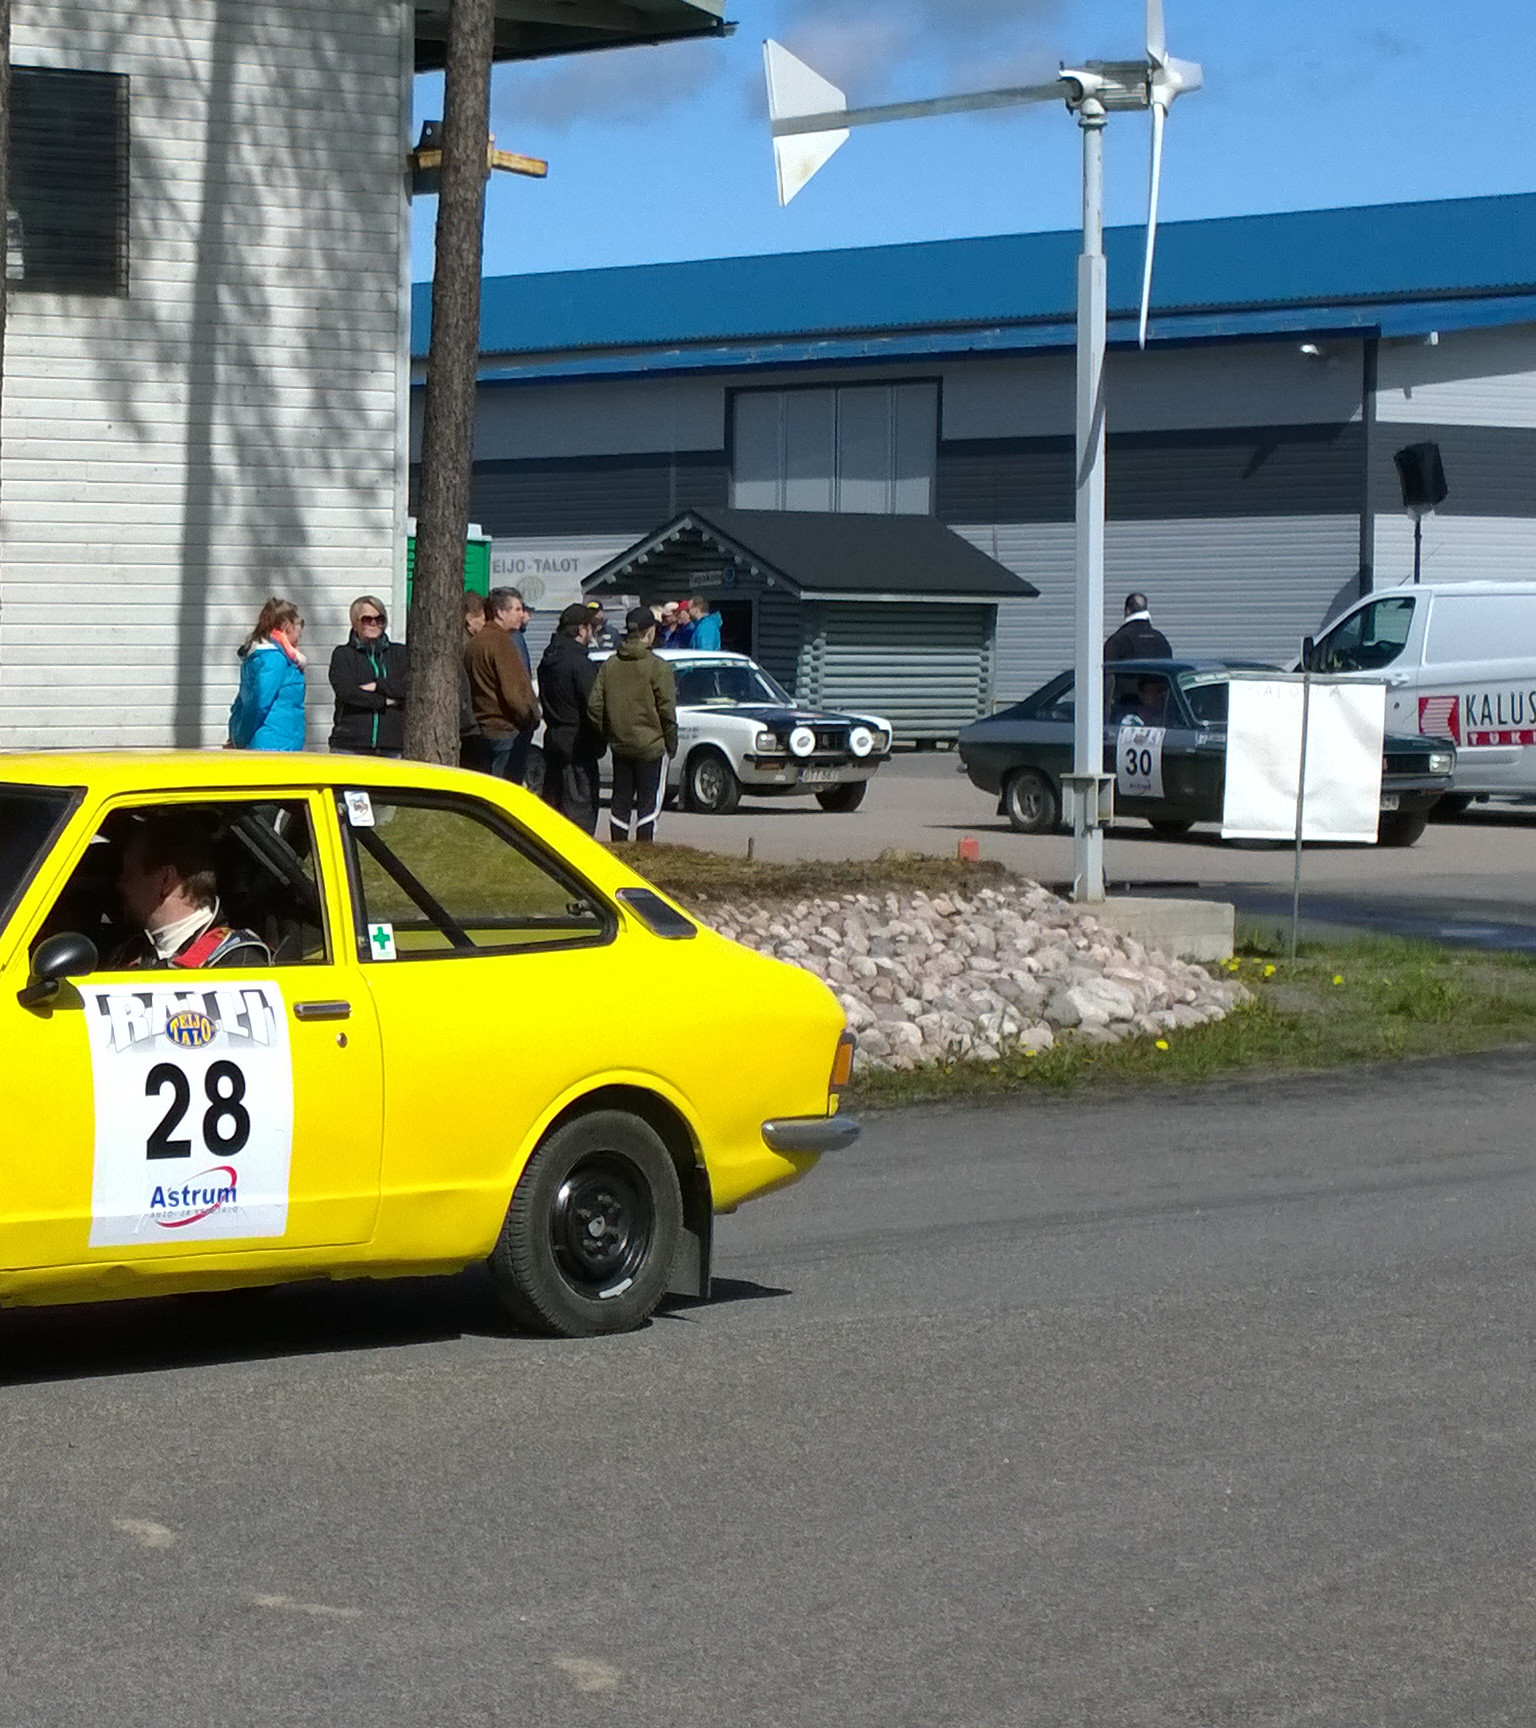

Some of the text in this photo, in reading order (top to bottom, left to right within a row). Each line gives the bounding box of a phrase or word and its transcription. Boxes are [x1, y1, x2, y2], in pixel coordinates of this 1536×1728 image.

[1465, 690, 1536, 727] KALUS
[1125, 748, 1152, 776] 30
[107, 988, 271, 1054] RALLI
[144, 1059, 251, 1160] 28
[150, 1183, 237, 1209] Astrum
